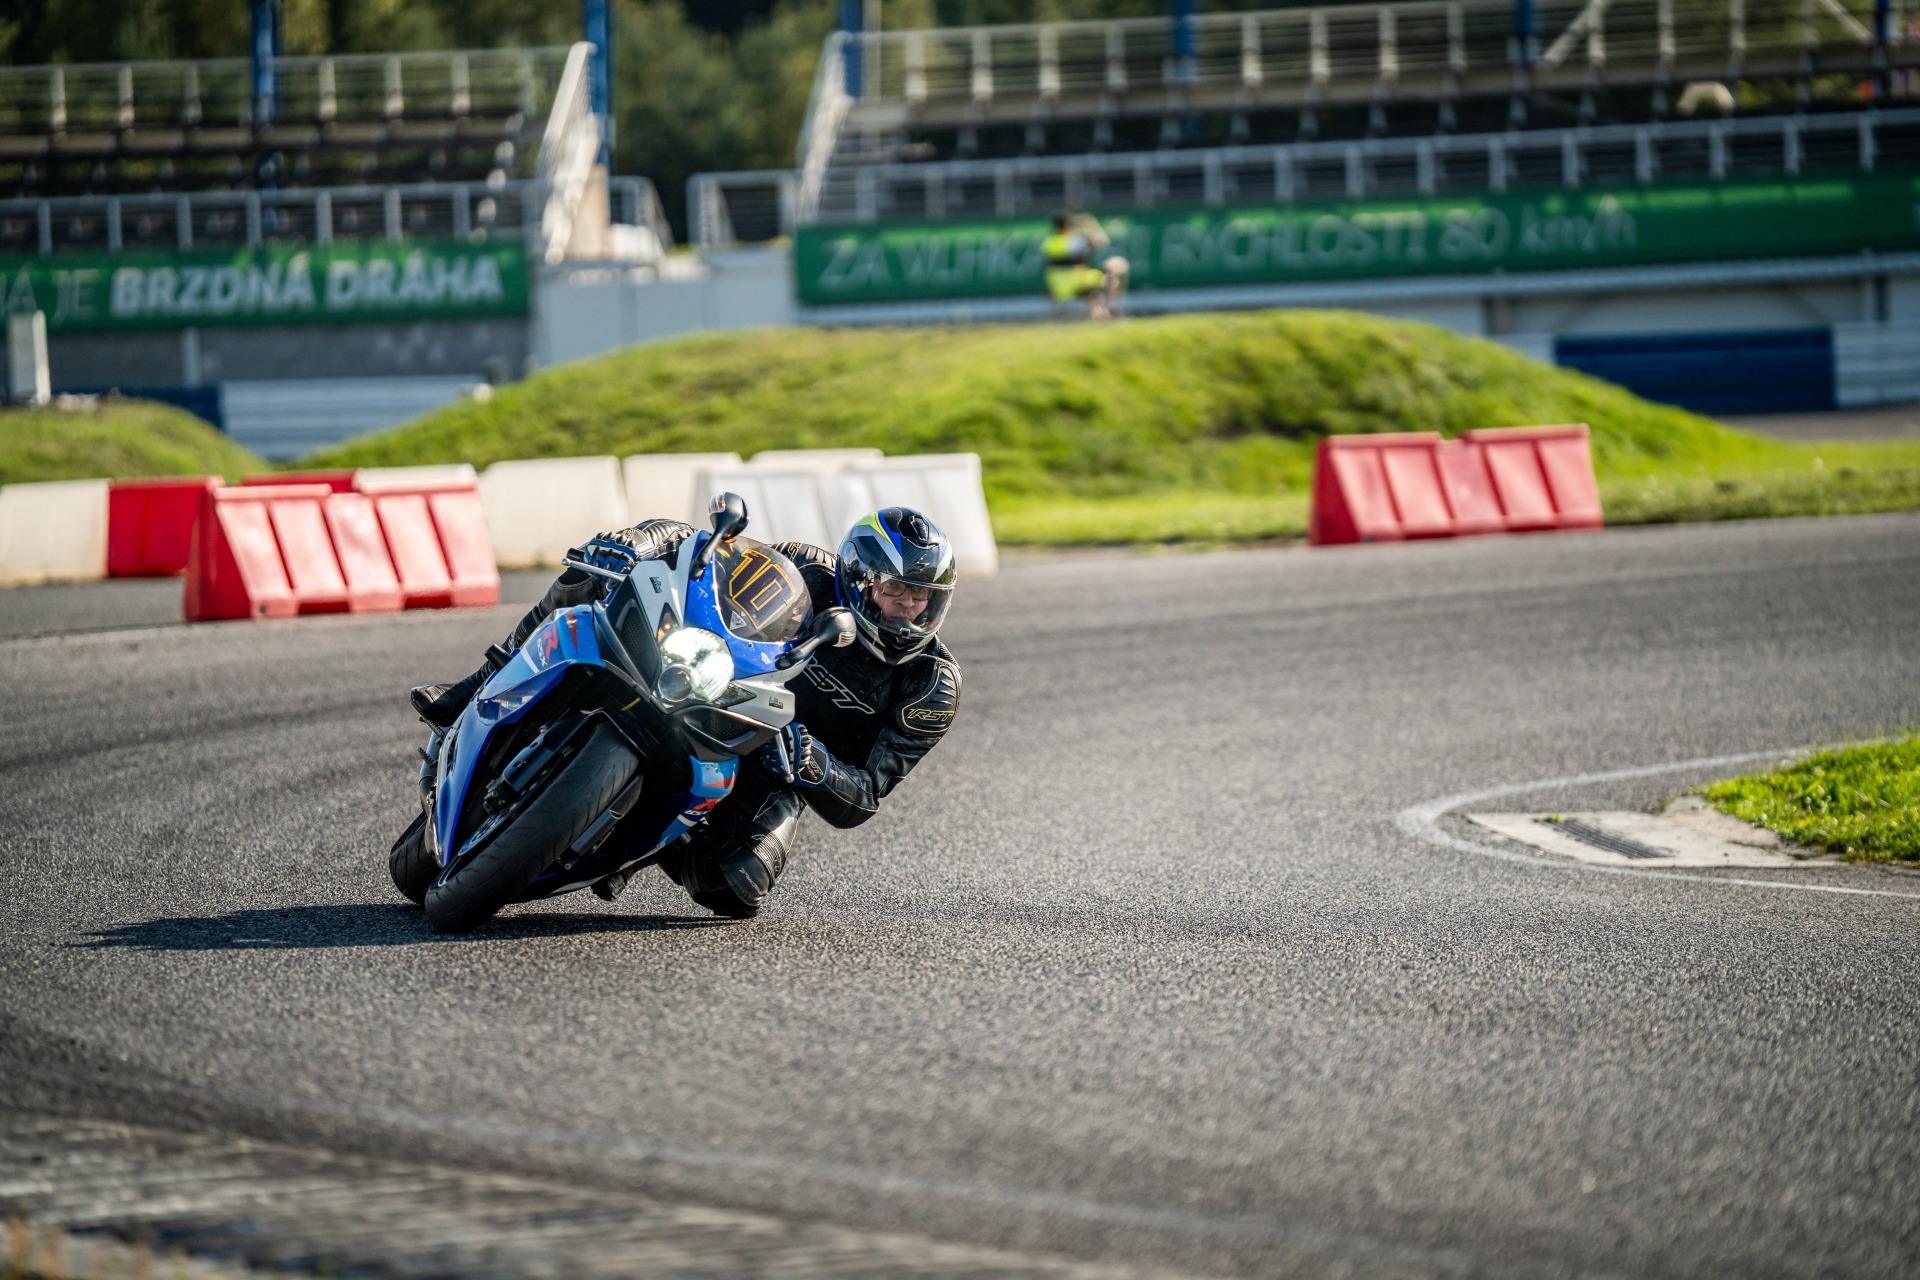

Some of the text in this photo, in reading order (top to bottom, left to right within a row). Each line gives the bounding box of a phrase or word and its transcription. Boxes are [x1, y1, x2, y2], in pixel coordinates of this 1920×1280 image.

[1438, 206, 1511, 262] 80
[112, 253, 316, 315] BRZDNÁ
[325, 249, 503, 309] DRÁHA
[728, 547, 797, 630] 10
[907, 708, 955, 722] RST
